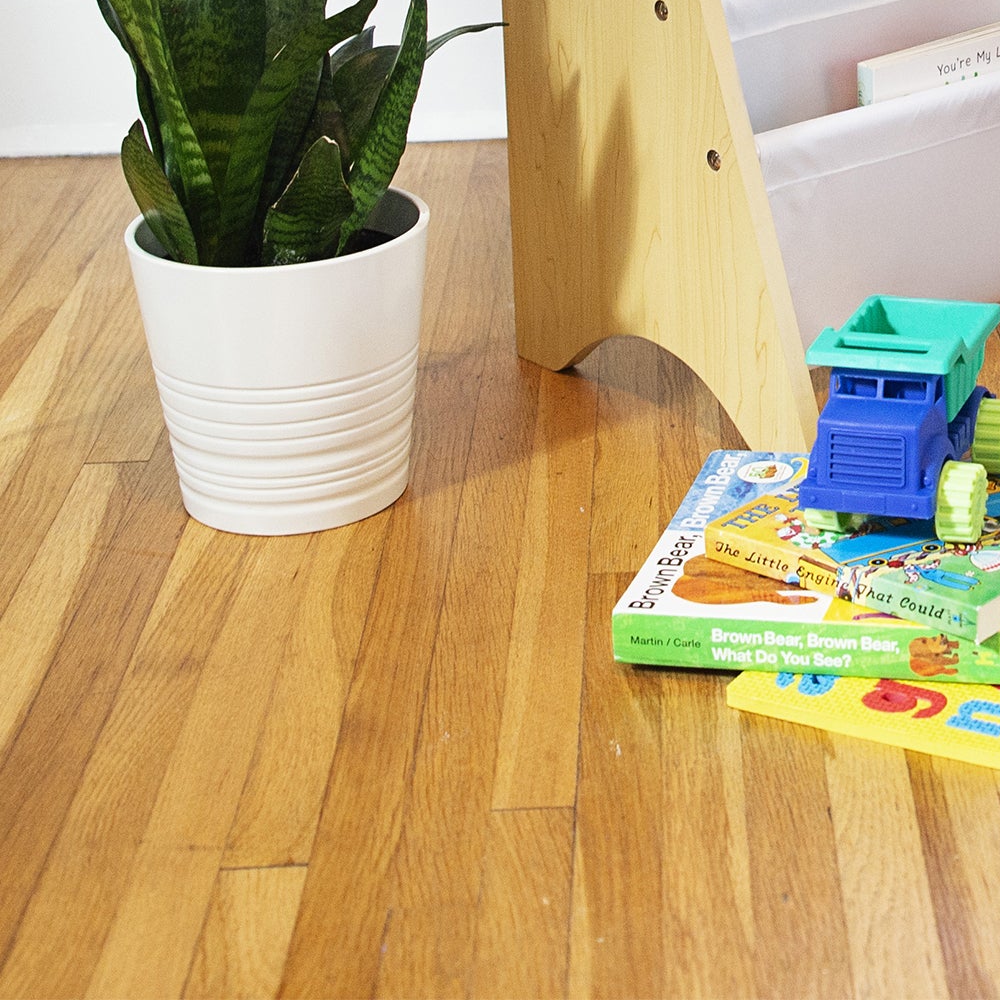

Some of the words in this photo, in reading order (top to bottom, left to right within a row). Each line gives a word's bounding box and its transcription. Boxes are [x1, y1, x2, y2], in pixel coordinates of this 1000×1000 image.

[936, 57, 972, 76] You're
[976, 50, 991, 64] My
[721, 503, 780, 529] THE
[628, 568, 678, 610] Brown
[656, 533, 704, 568] Bear,
[680, 485, 726, 529] Brown
[715, 541, 740, 558] The
[744, 551, 789, 573] Little
[796, 565, 850, 591] Engine
[858, 583, 894, 605] That
[899, 596, 945, 620] Could
[630, 635, 664, 647] Martin
[673, 637, 701, 649] Carle
[711, 627, 761, 645] Brown
[764, 630, 804, 649] Bear,
[807, 632, 858, 650] Brown
[860, 635, 900, 655] Bear,
[711, 646, 753, 663] What
[755, 649, 778, 664] Do
[780, 651, 810, 666] You
[813, 652, 852, 668] See?
